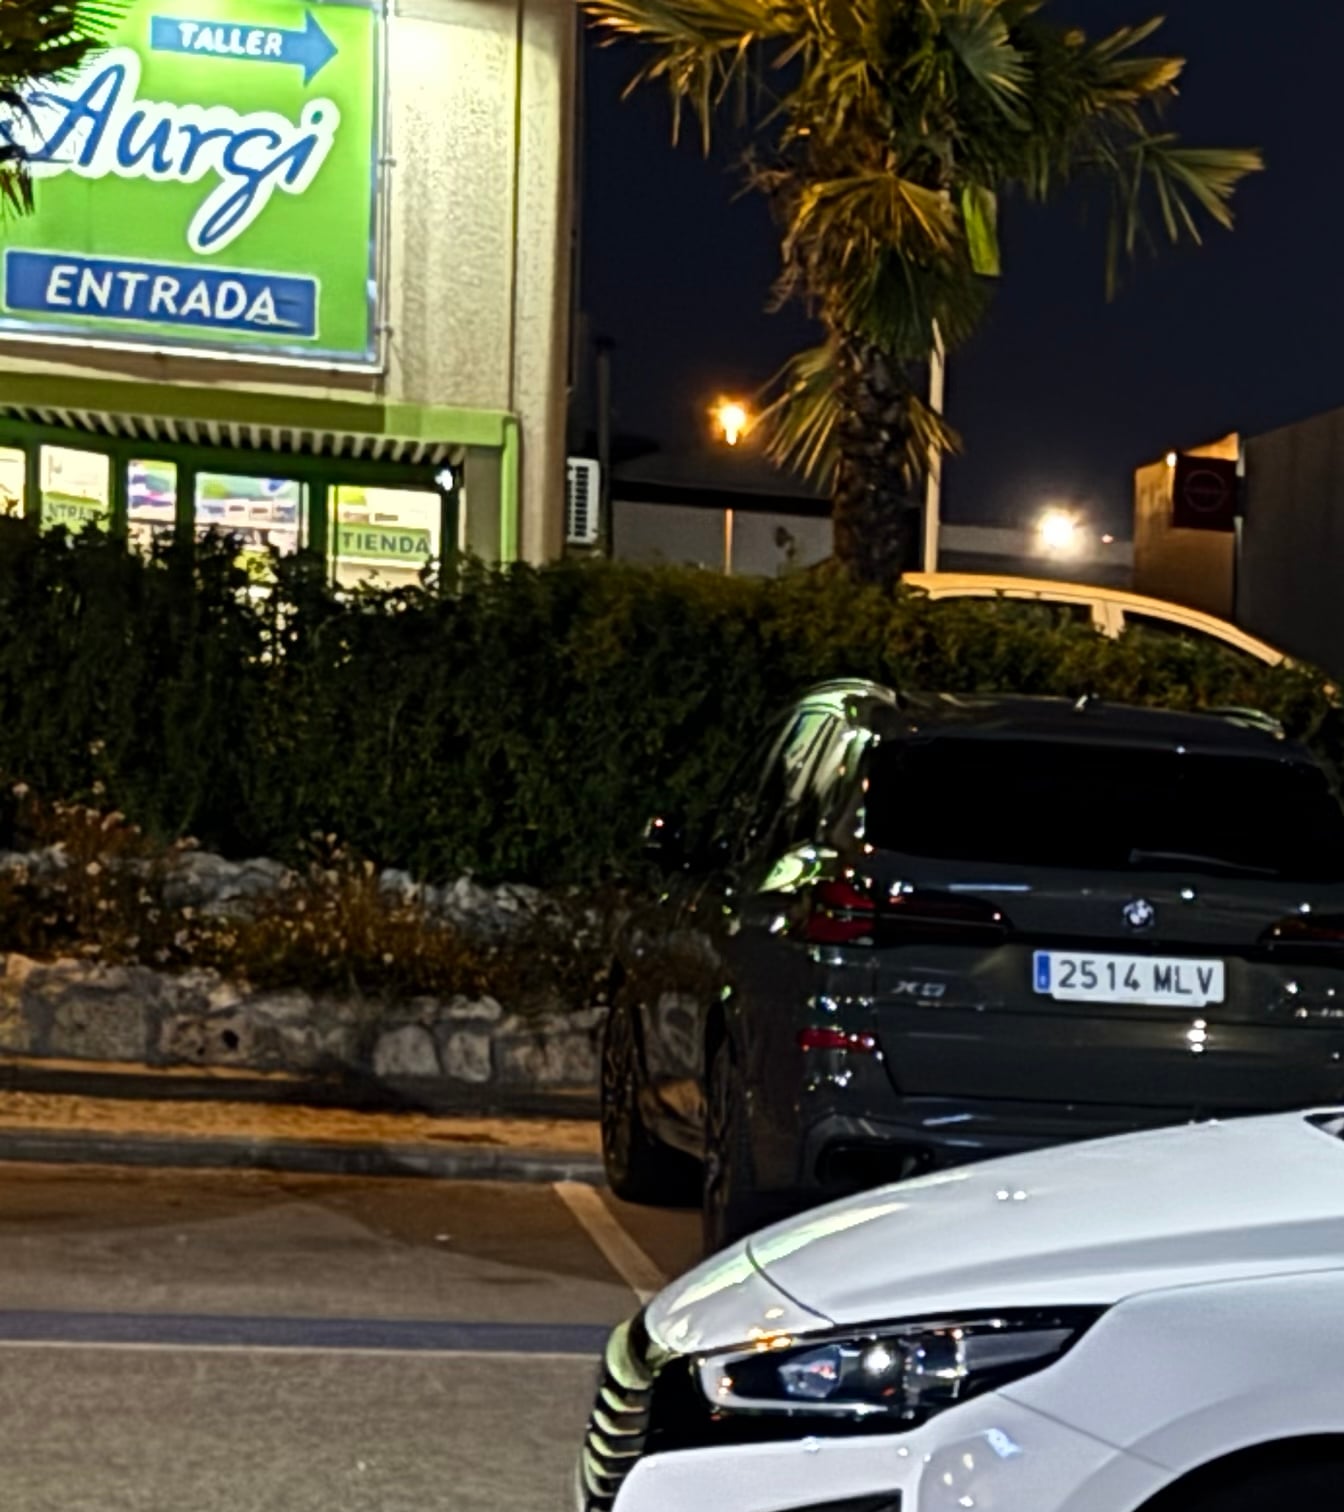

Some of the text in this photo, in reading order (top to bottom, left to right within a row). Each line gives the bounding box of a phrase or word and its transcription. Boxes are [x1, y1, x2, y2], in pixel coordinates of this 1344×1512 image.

[177, 21, 283, 58] TALLER
[0, 62, 322, 248] Aurgi
[45, 264, 279, 324] ENTRADA
[340, 531, 432, 555] TIENDA
[1057, 958, 1214, 996] 2514 MLV
